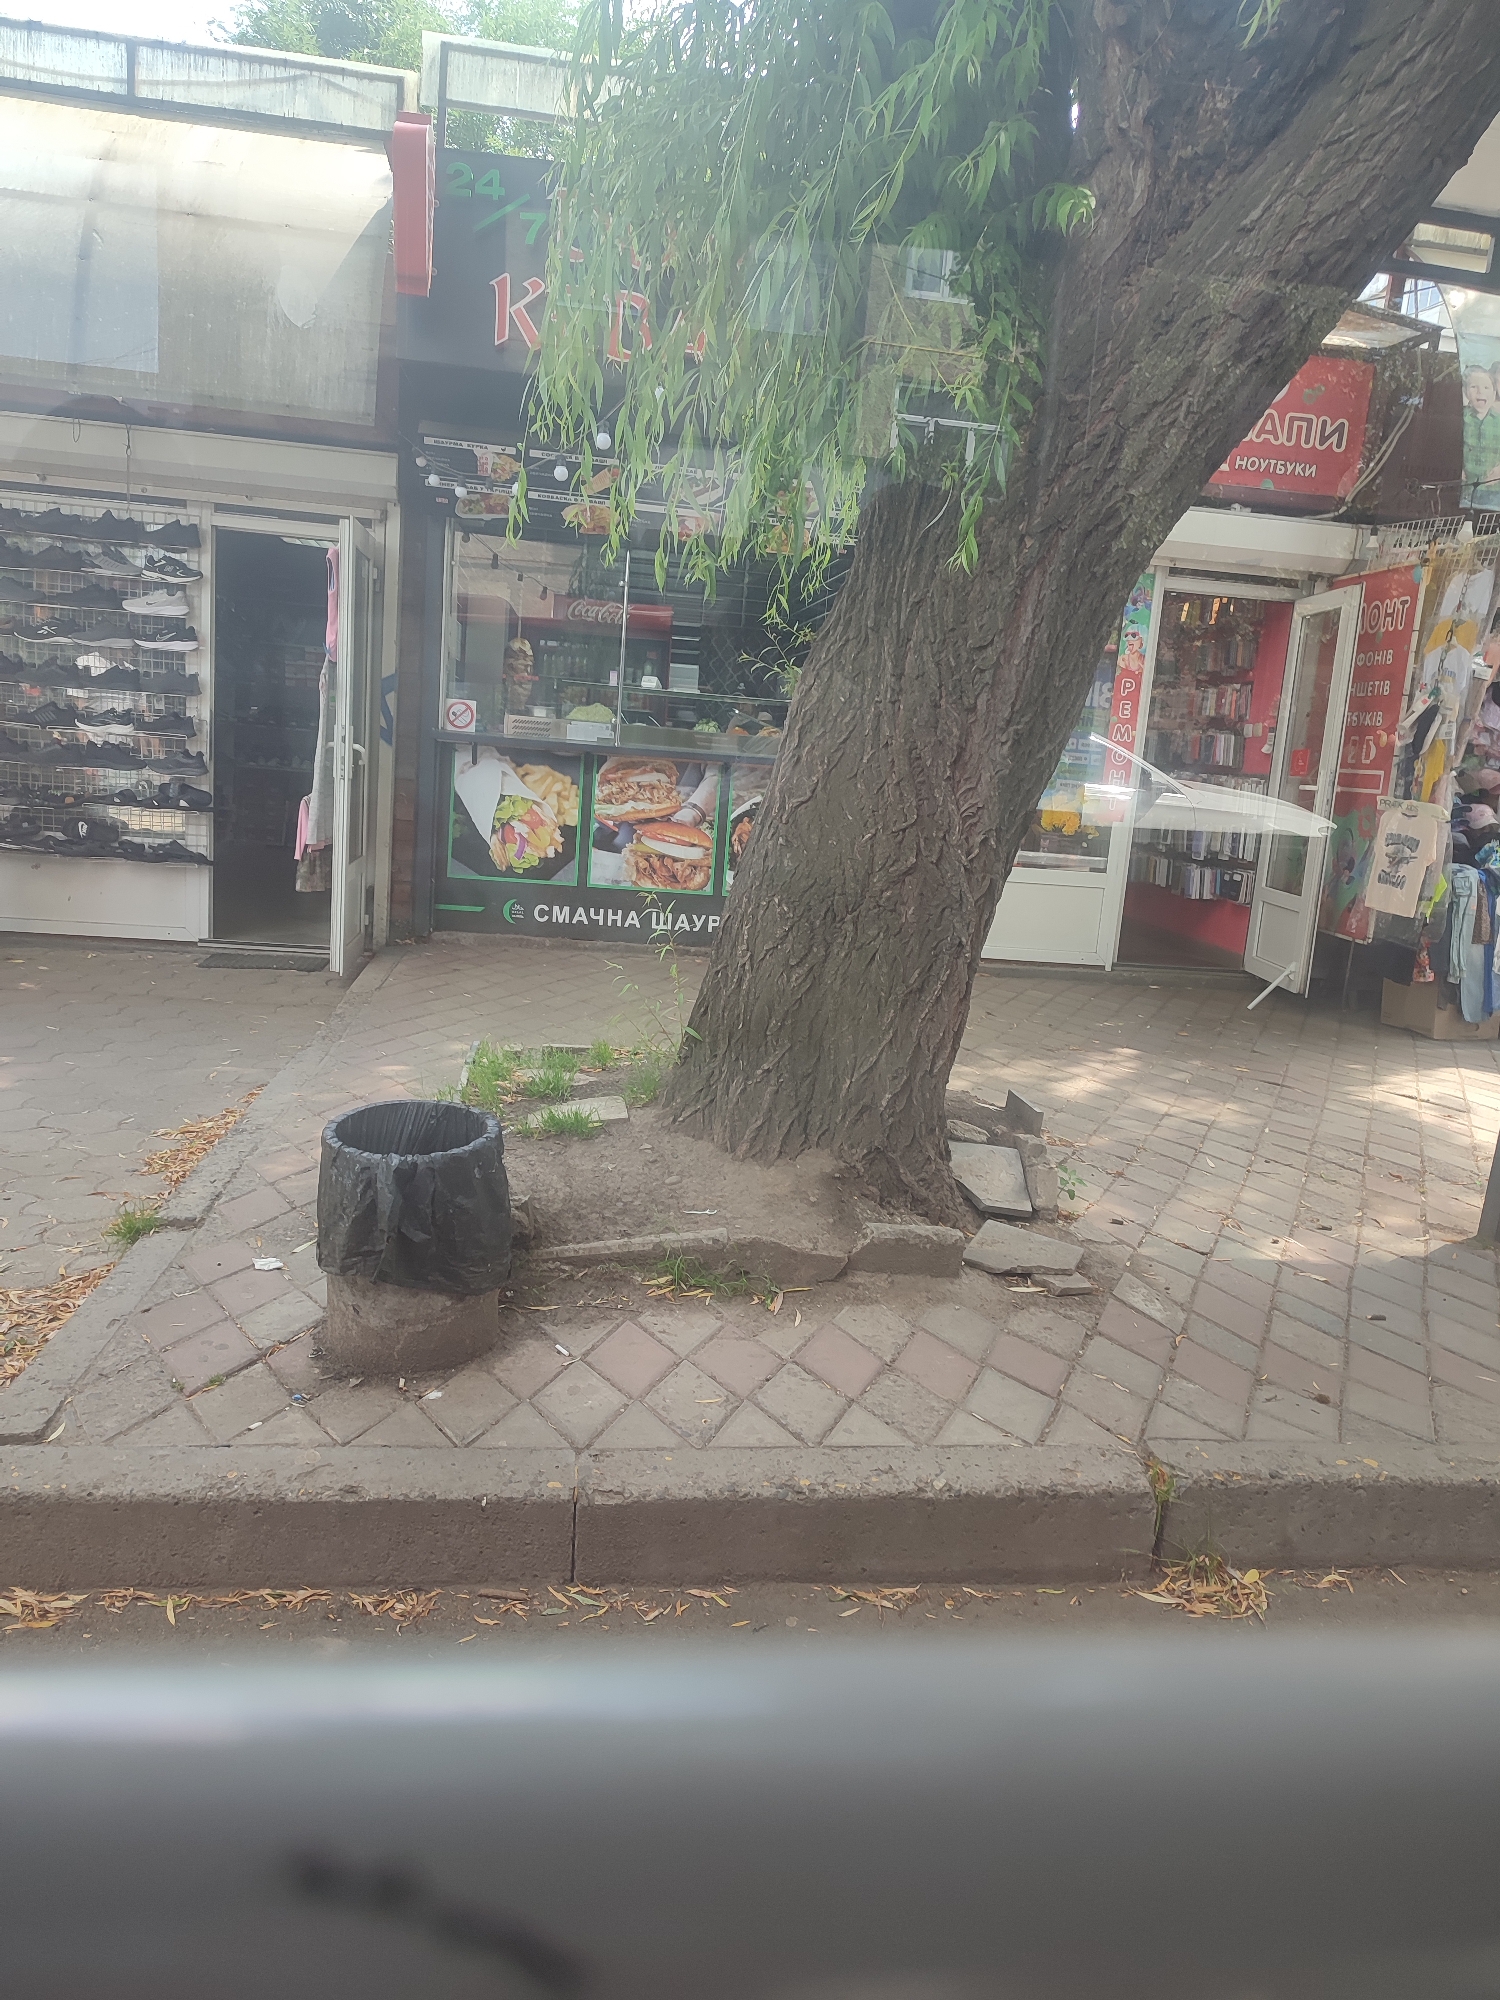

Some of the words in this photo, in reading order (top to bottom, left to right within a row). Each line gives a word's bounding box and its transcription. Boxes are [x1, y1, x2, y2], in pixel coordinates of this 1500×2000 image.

[446, 162, 546, 245] 24/7
[1243, 409, 1349, 453] АПИ
[1235, 455, 1317, 478] НОУТБУКИ
[533, 904, 641, 929] СМАЧНА
[651, 911, 721, 933] ШАУР
